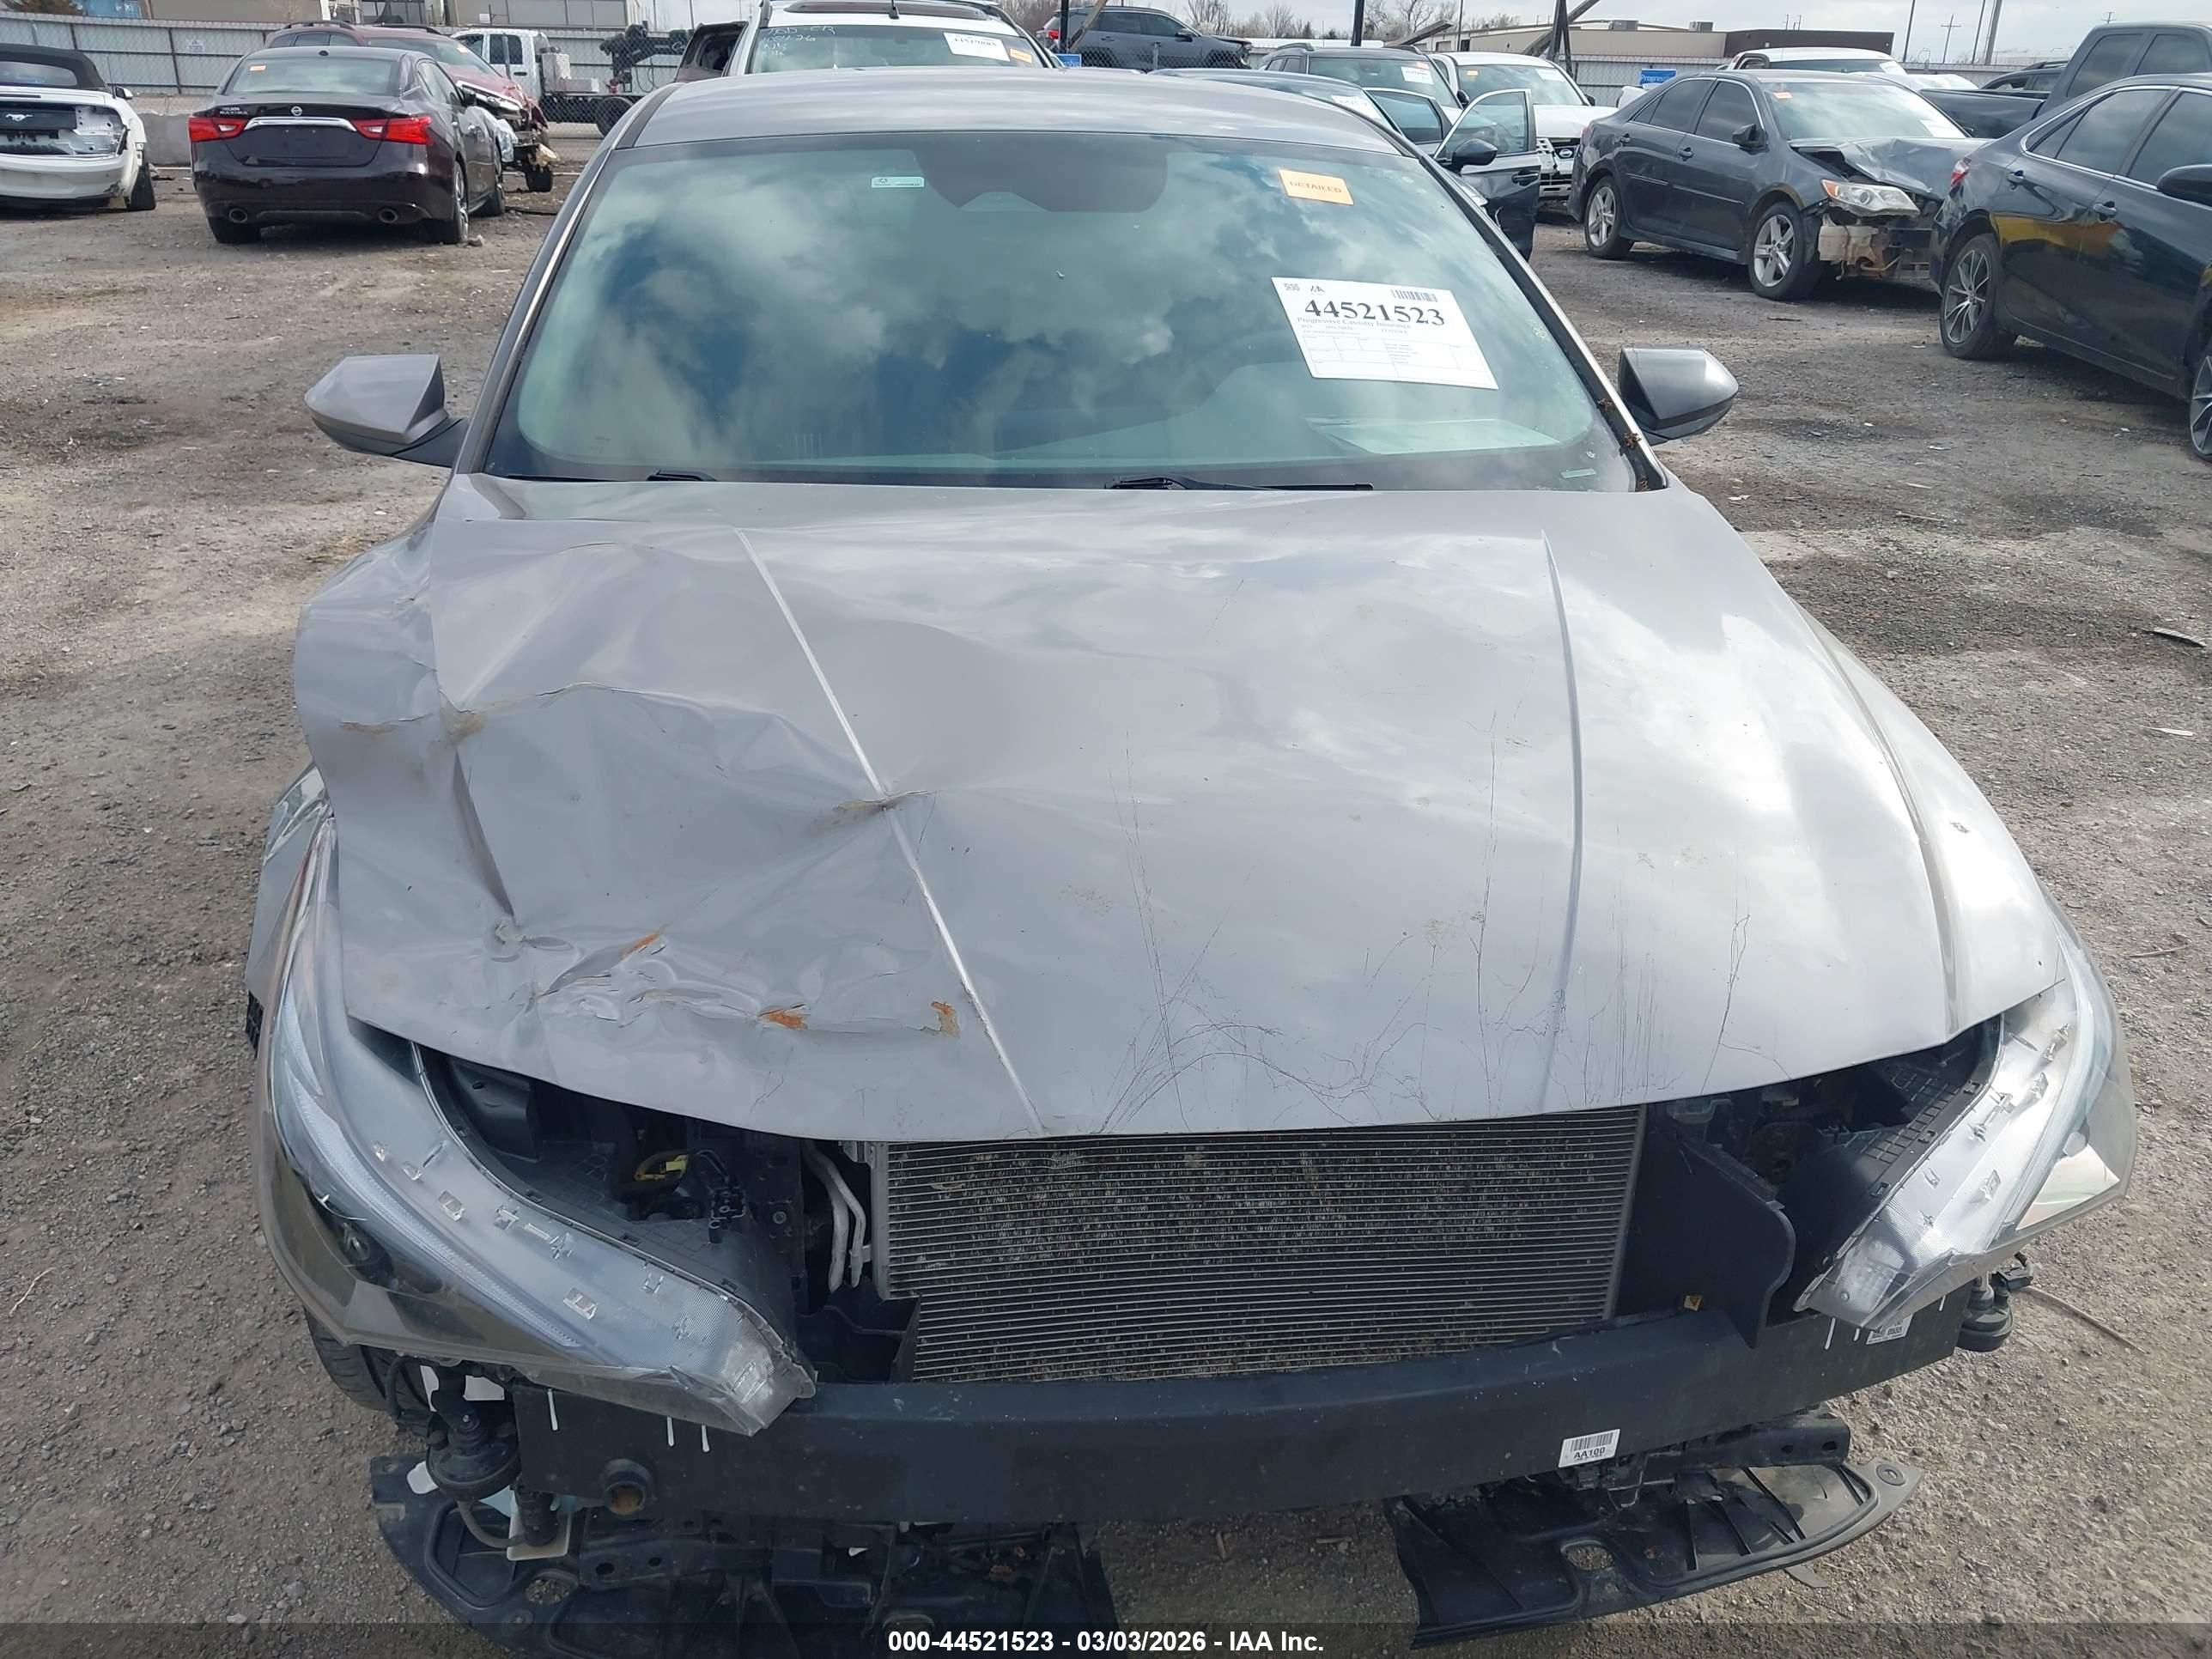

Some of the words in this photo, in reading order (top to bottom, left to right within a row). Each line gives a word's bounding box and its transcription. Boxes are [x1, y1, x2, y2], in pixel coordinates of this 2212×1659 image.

[1289, 179, 1342, 194] DETAILED
[1304, 299, 1445, 326] 44521523
[1297, 315, 1341, 325] Progressive
[1342, 318, 1374, 328] Casualty
